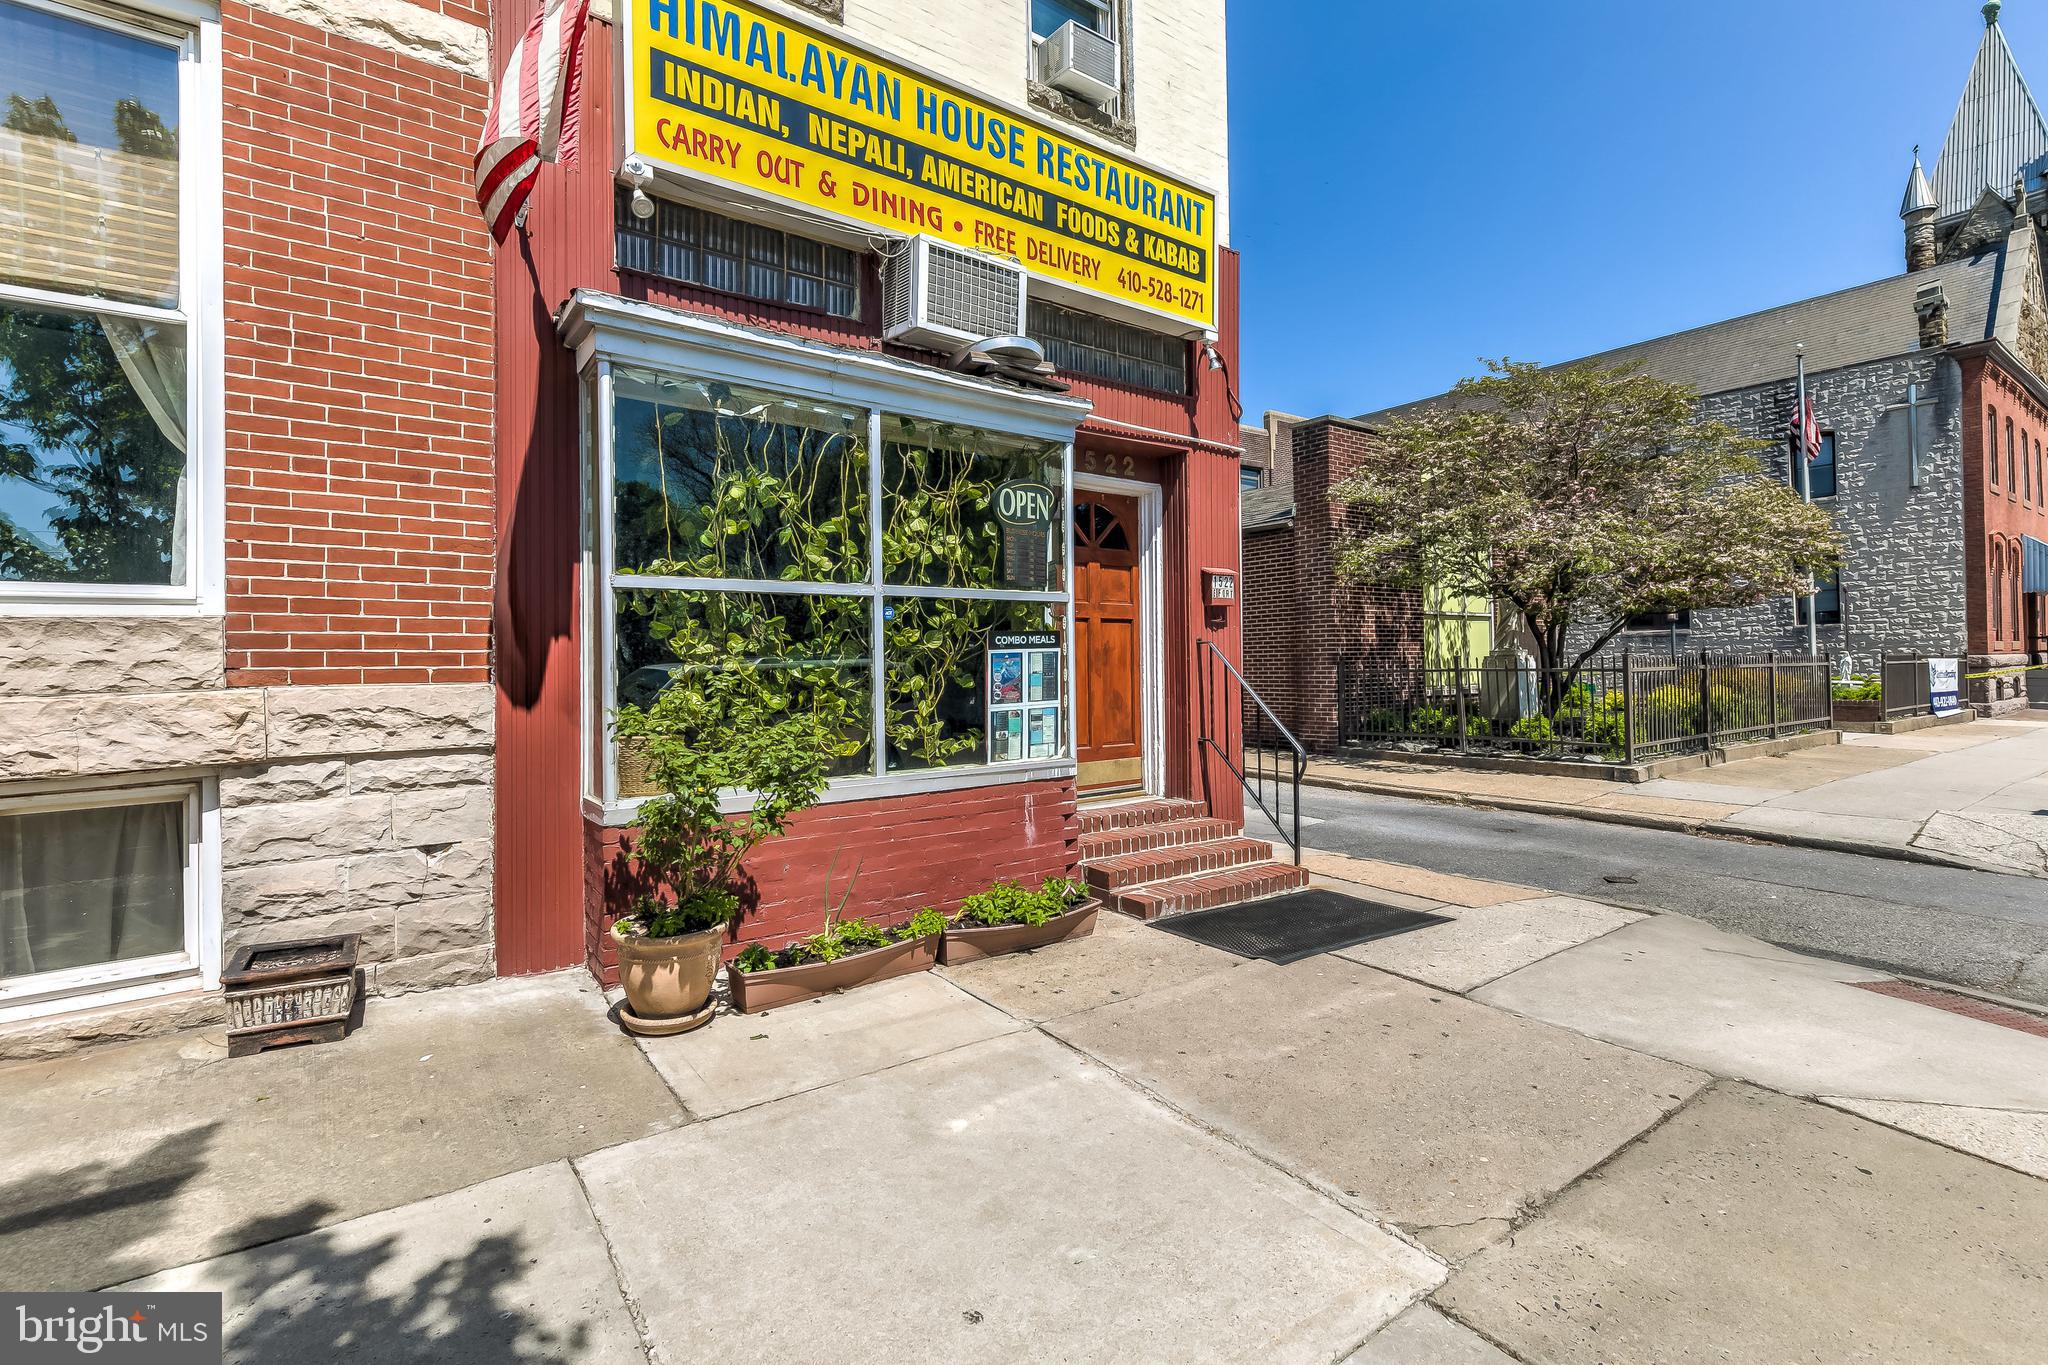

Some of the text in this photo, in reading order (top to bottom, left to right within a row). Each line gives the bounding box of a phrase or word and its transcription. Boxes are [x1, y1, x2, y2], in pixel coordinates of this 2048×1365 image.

[664, 59, 1201, 275] INDIAN, NEPALI, AMERICAN FOODS & KABAB
[916, 86, 1025, 168] HOUSE
[1036, 135, 1206, 236] RESTAURANT
[656, 118, 1205, 314] CARRY OUT & DINING FREE DELIVERY 410-528-1271
[999, 488, 1049, 521] OPEN
[1213, 576, 1233, 588] 1522
[995, 635, 1056, 645] COMBO MEALS
